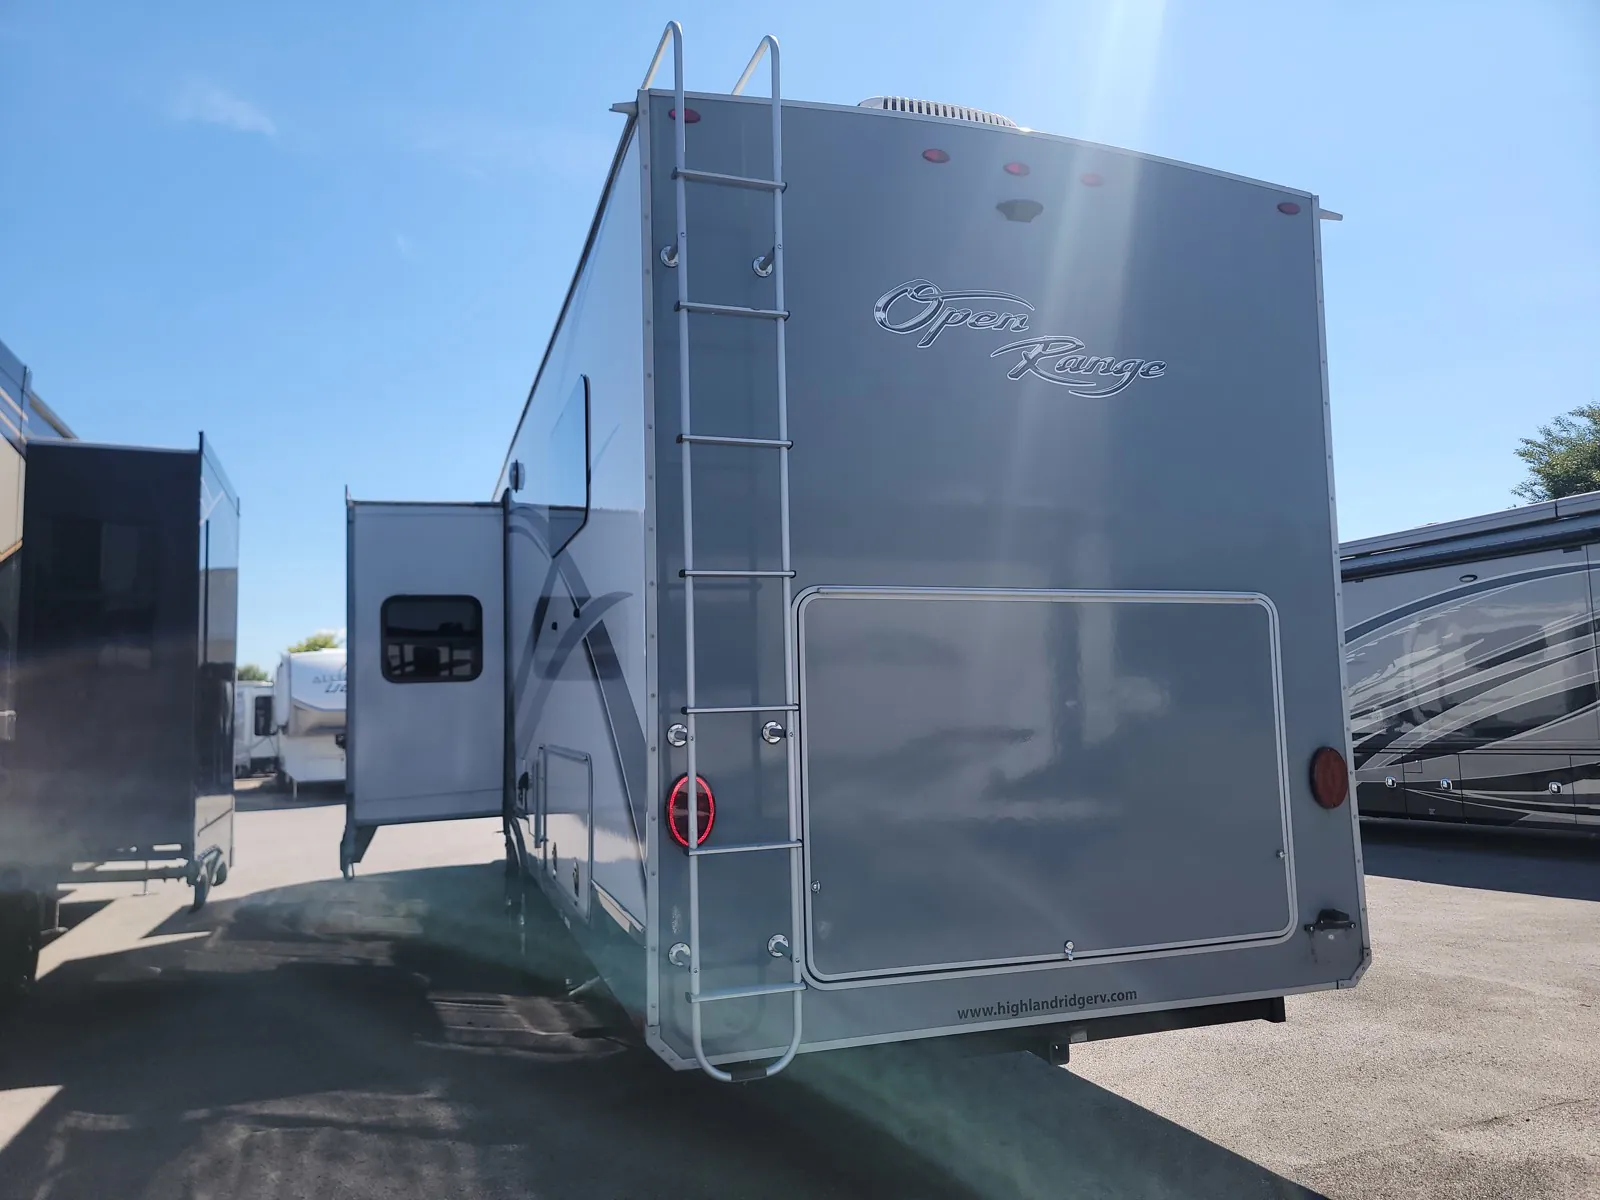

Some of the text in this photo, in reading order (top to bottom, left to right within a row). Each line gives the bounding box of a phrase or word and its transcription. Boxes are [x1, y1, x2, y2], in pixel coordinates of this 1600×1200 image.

[874, 278, 1035, 348] Open
[990, 335, 1166, 398] Range
[957, 990, 1137, 1020] www.highlandridgerv.com
